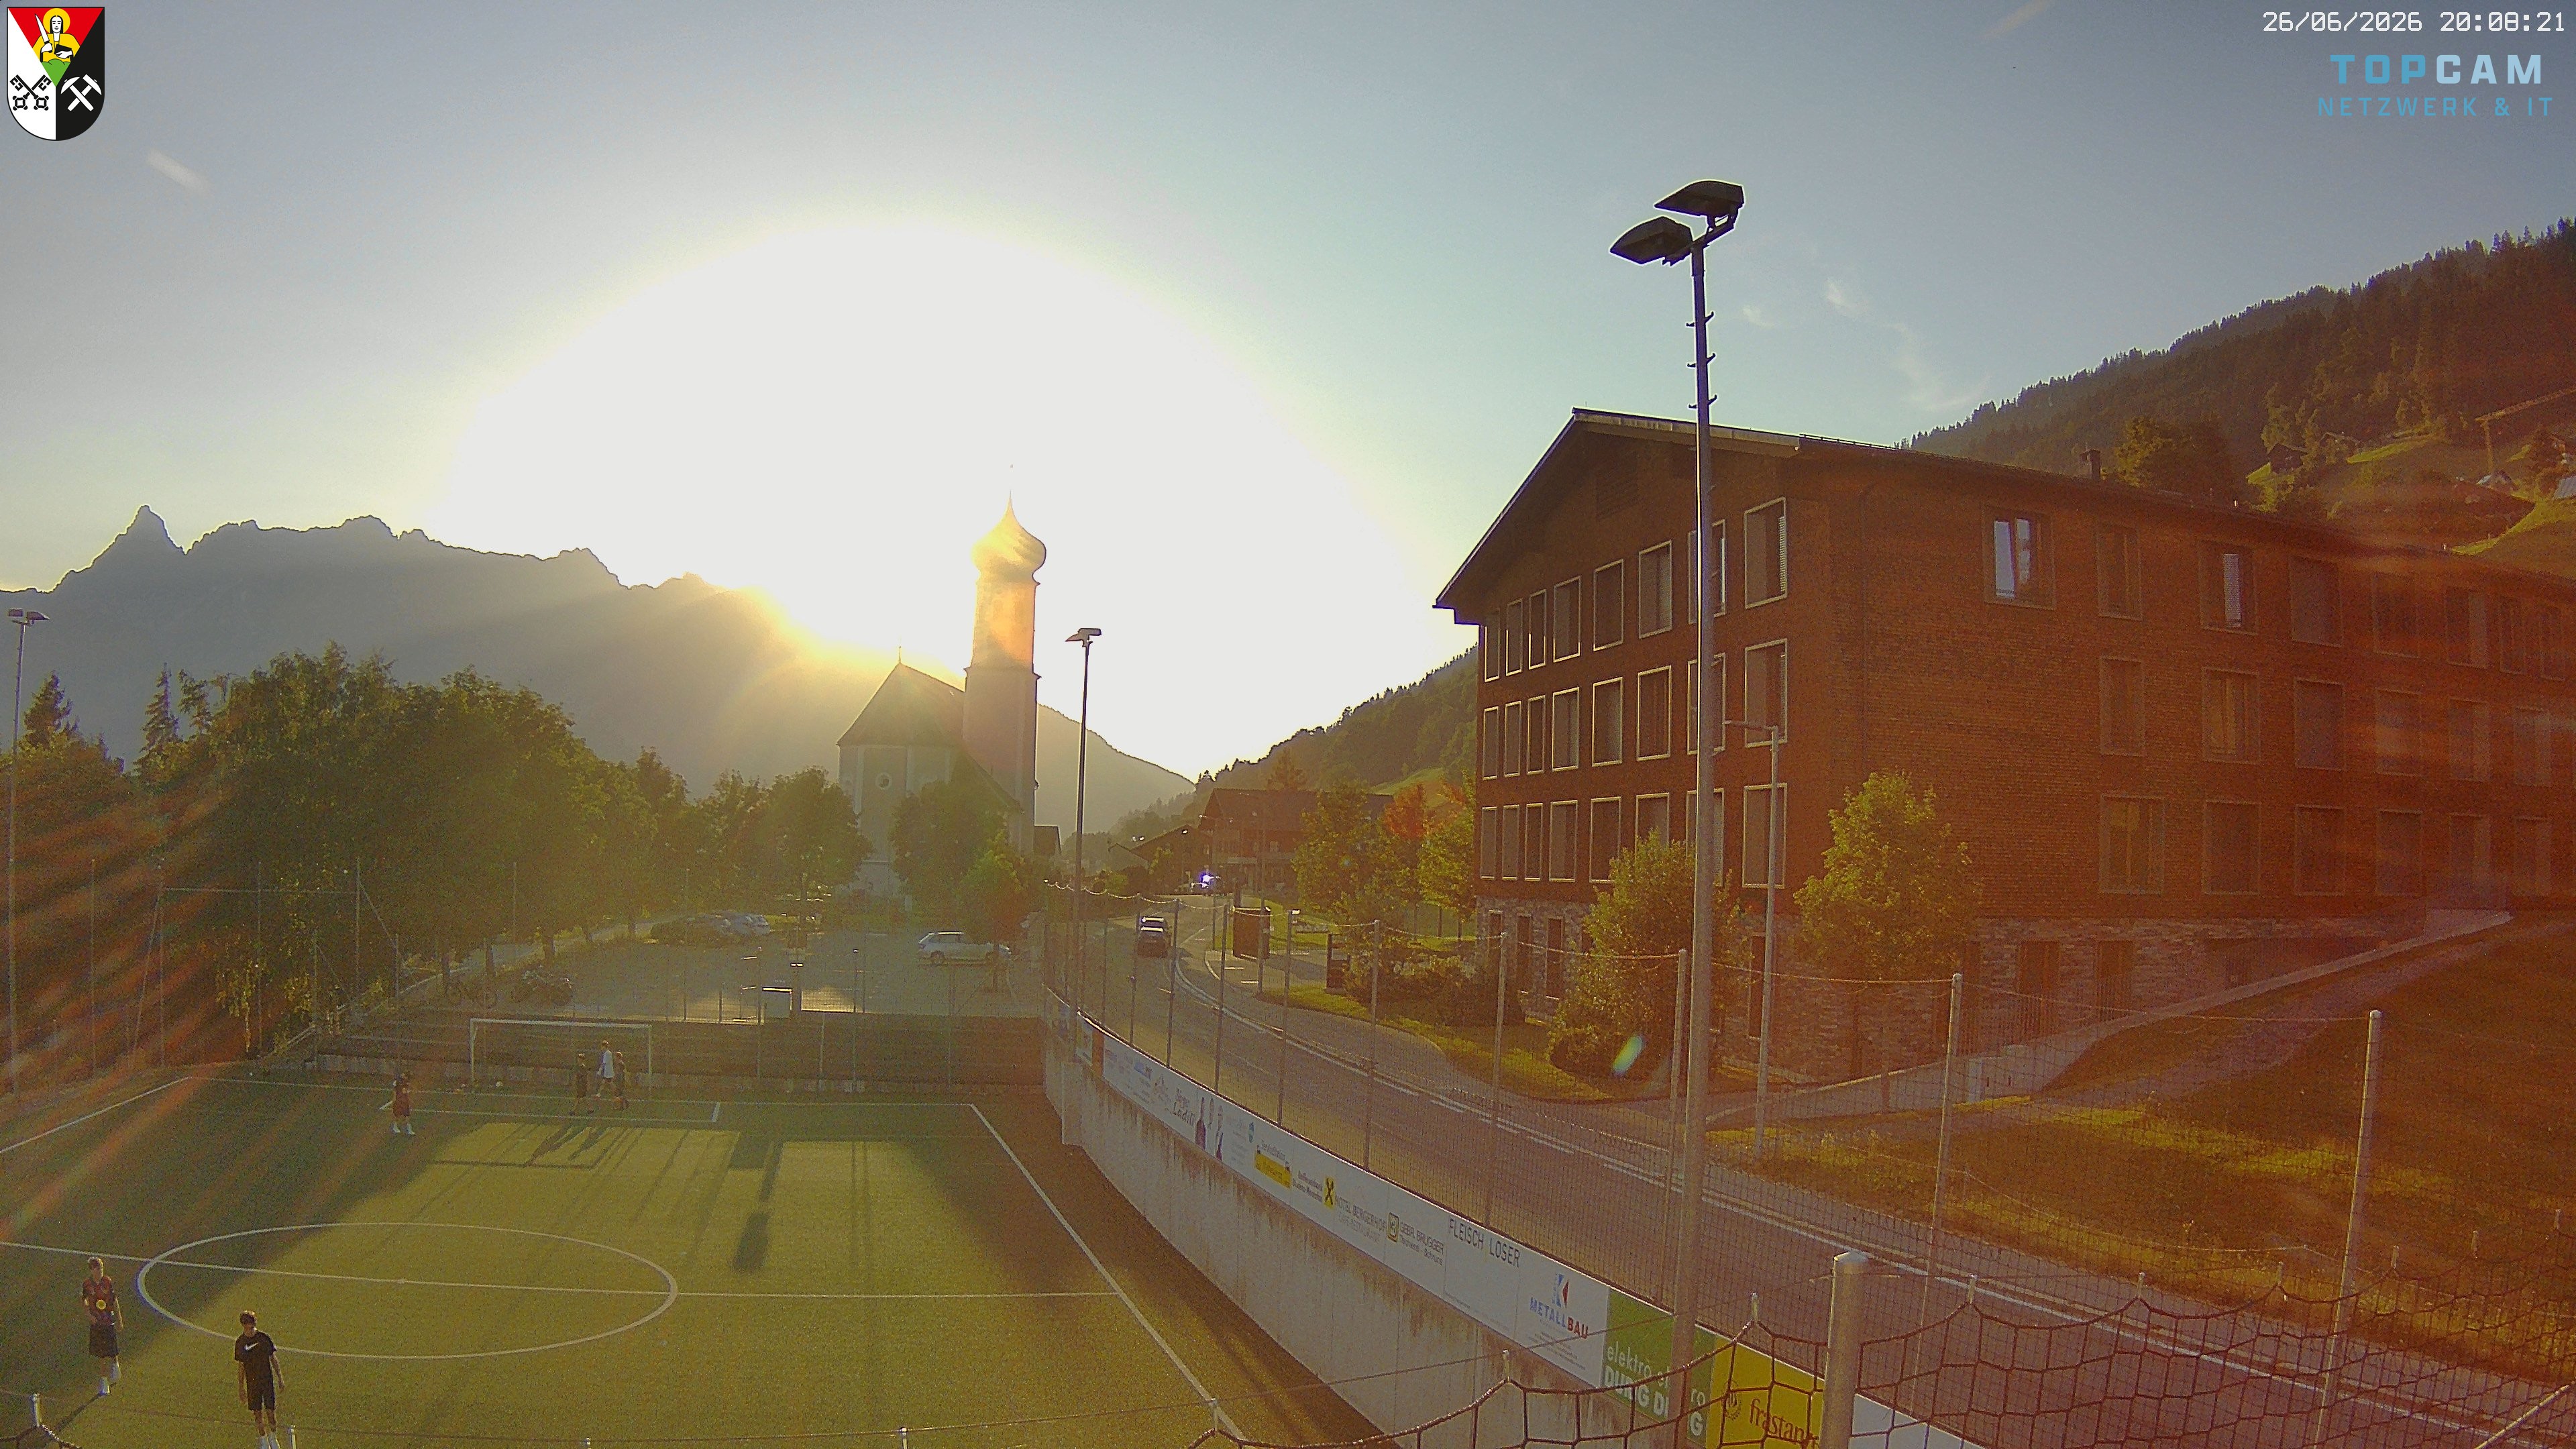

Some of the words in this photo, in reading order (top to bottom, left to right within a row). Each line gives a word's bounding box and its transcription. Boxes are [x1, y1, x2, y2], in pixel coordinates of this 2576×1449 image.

[1449, 1218, 1485, 1250] FLEISCH
[1489, 1237, 1521, 1268] LOSER
[1529, 1297, 1589, 1340] METALLBAU
[1607, 1340, 1652, 1379] elektro
